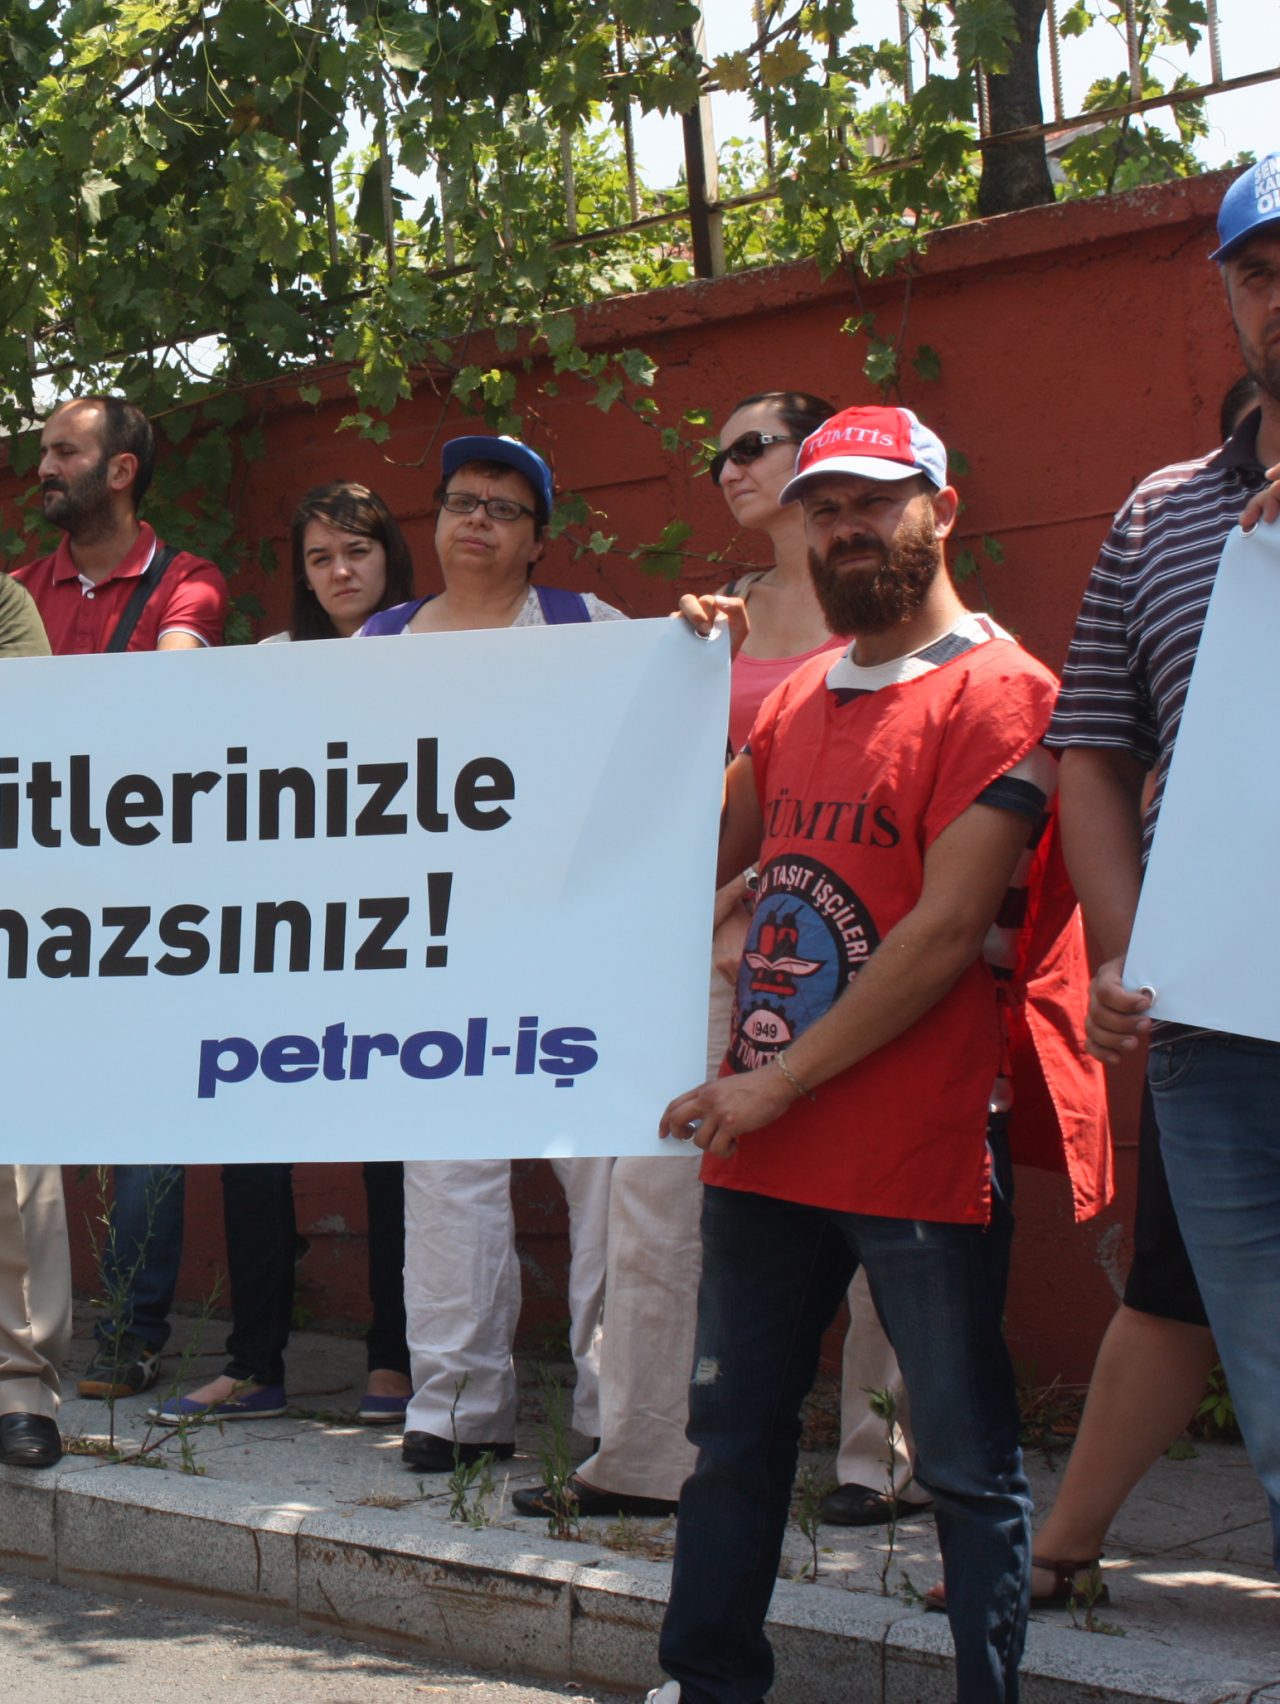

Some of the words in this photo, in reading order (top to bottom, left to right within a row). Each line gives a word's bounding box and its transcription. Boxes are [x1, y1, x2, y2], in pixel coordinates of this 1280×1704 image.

[772, 865, 814, 890] TAŞIT
[751, 1021, 777, 1038] 1949
[198, 1017, 597, 1098] petrol-iş
